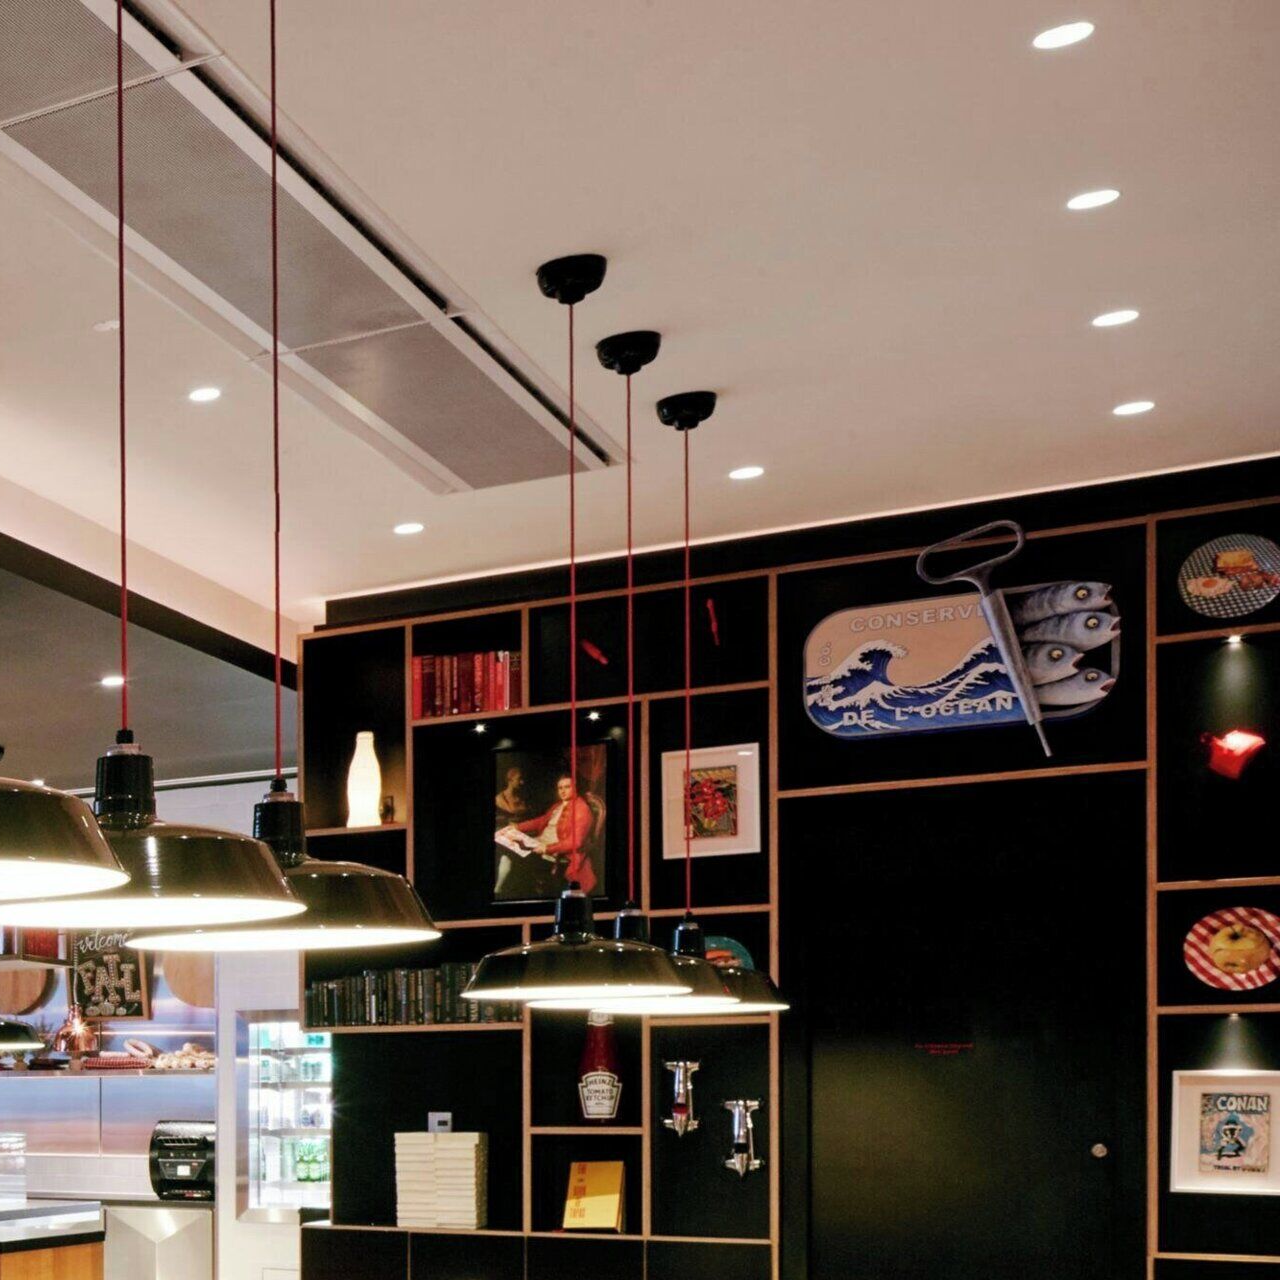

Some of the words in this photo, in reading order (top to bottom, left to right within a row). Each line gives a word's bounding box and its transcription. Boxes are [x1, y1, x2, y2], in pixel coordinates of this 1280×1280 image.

[842, 709, 876, 727] DE
[894, 695, 1014, 722] L'OCEAN
[1216, 1095, 1268, 1111] CONAN
